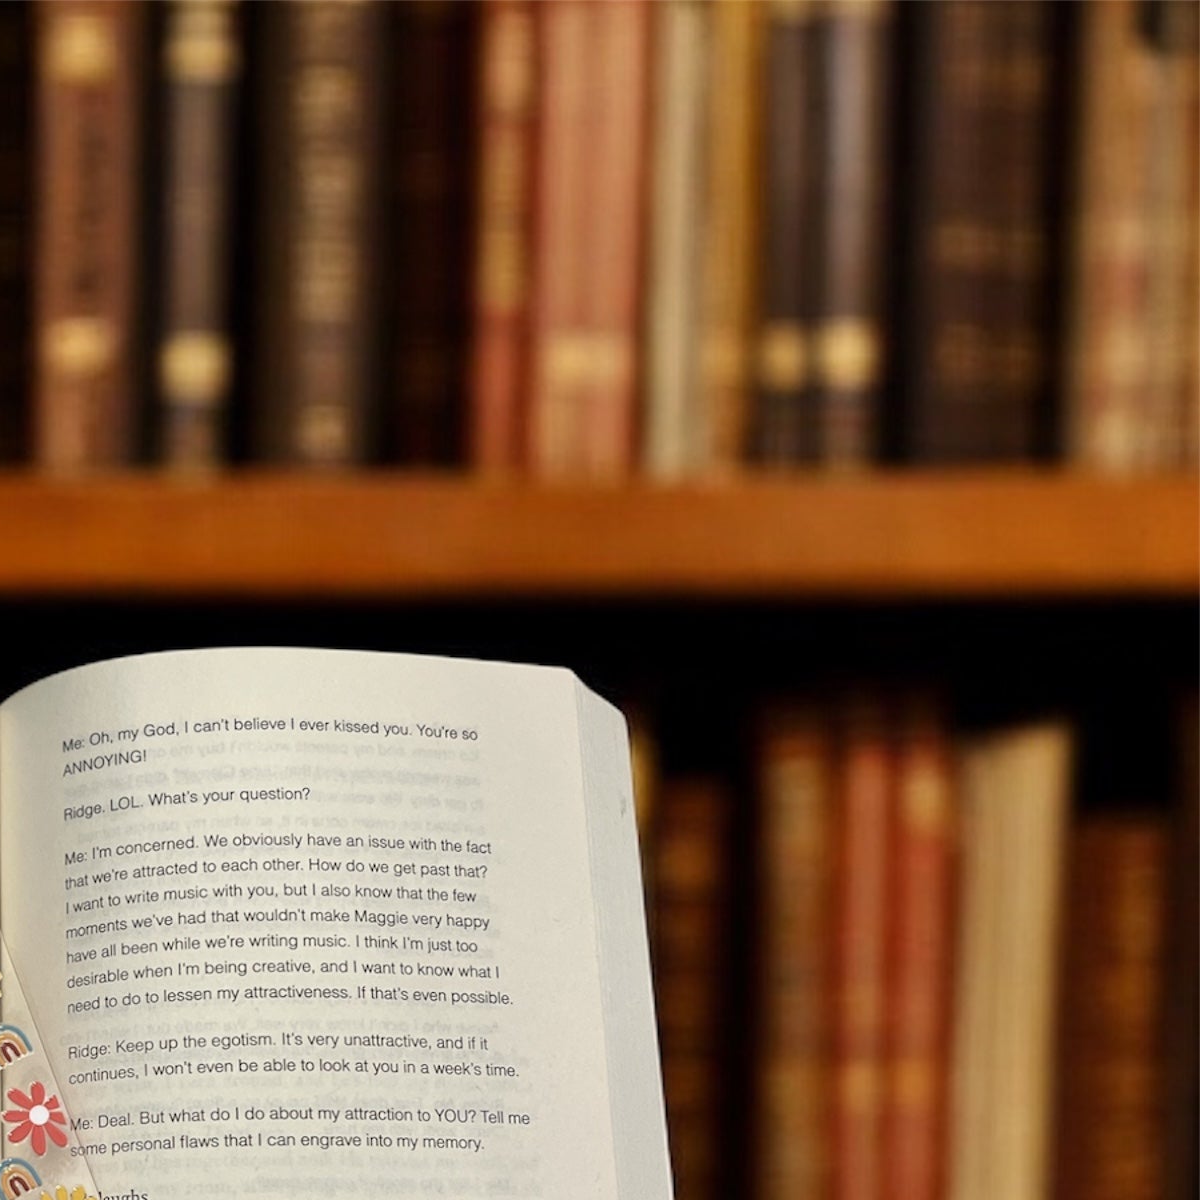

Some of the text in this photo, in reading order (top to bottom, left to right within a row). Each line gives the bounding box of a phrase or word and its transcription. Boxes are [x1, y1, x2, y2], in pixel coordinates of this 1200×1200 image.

[63, 738, 85, 753] Me:
[89, 730, 113, 746] Oh,
[118, 728, 139, 742] my
[143, 722, 179, 738] God,
[193, 718, 229, 734] can't
[234, 717, 286, 731] believe
[299, 720, 329, 732] ever
[334, 719, 379, 734] kissed
[383, 724, 412, 738] you.
[416, 723, 458, 740] You're
[462, 729, 478, 741] so
[63, 748, 146, 778] ANNOYING!
[110, 795, 143, 812] LOL.
[148, 790, 198, 806] What's
[202, 790, 235, 805] your
[240, 786, 310, 803] question?
[68, 1031, 488, 1060] Ridge: Keep up the egotism. It's very unattractive, and if it
[70, 1143, 108, 1157] some
[112, 1135, 175, 1156] personal
[180, 1134, 219, 1149] flaws
[224, 1133, 253, 1148] that
[267, 1135, 296, 1147] can
[300, 1136, 361, 1151] engrave
[366, 1133, 392, 1148] into
[397, 1136, 418, 1151] my
[423, 1137, 484, 1153] memory.
